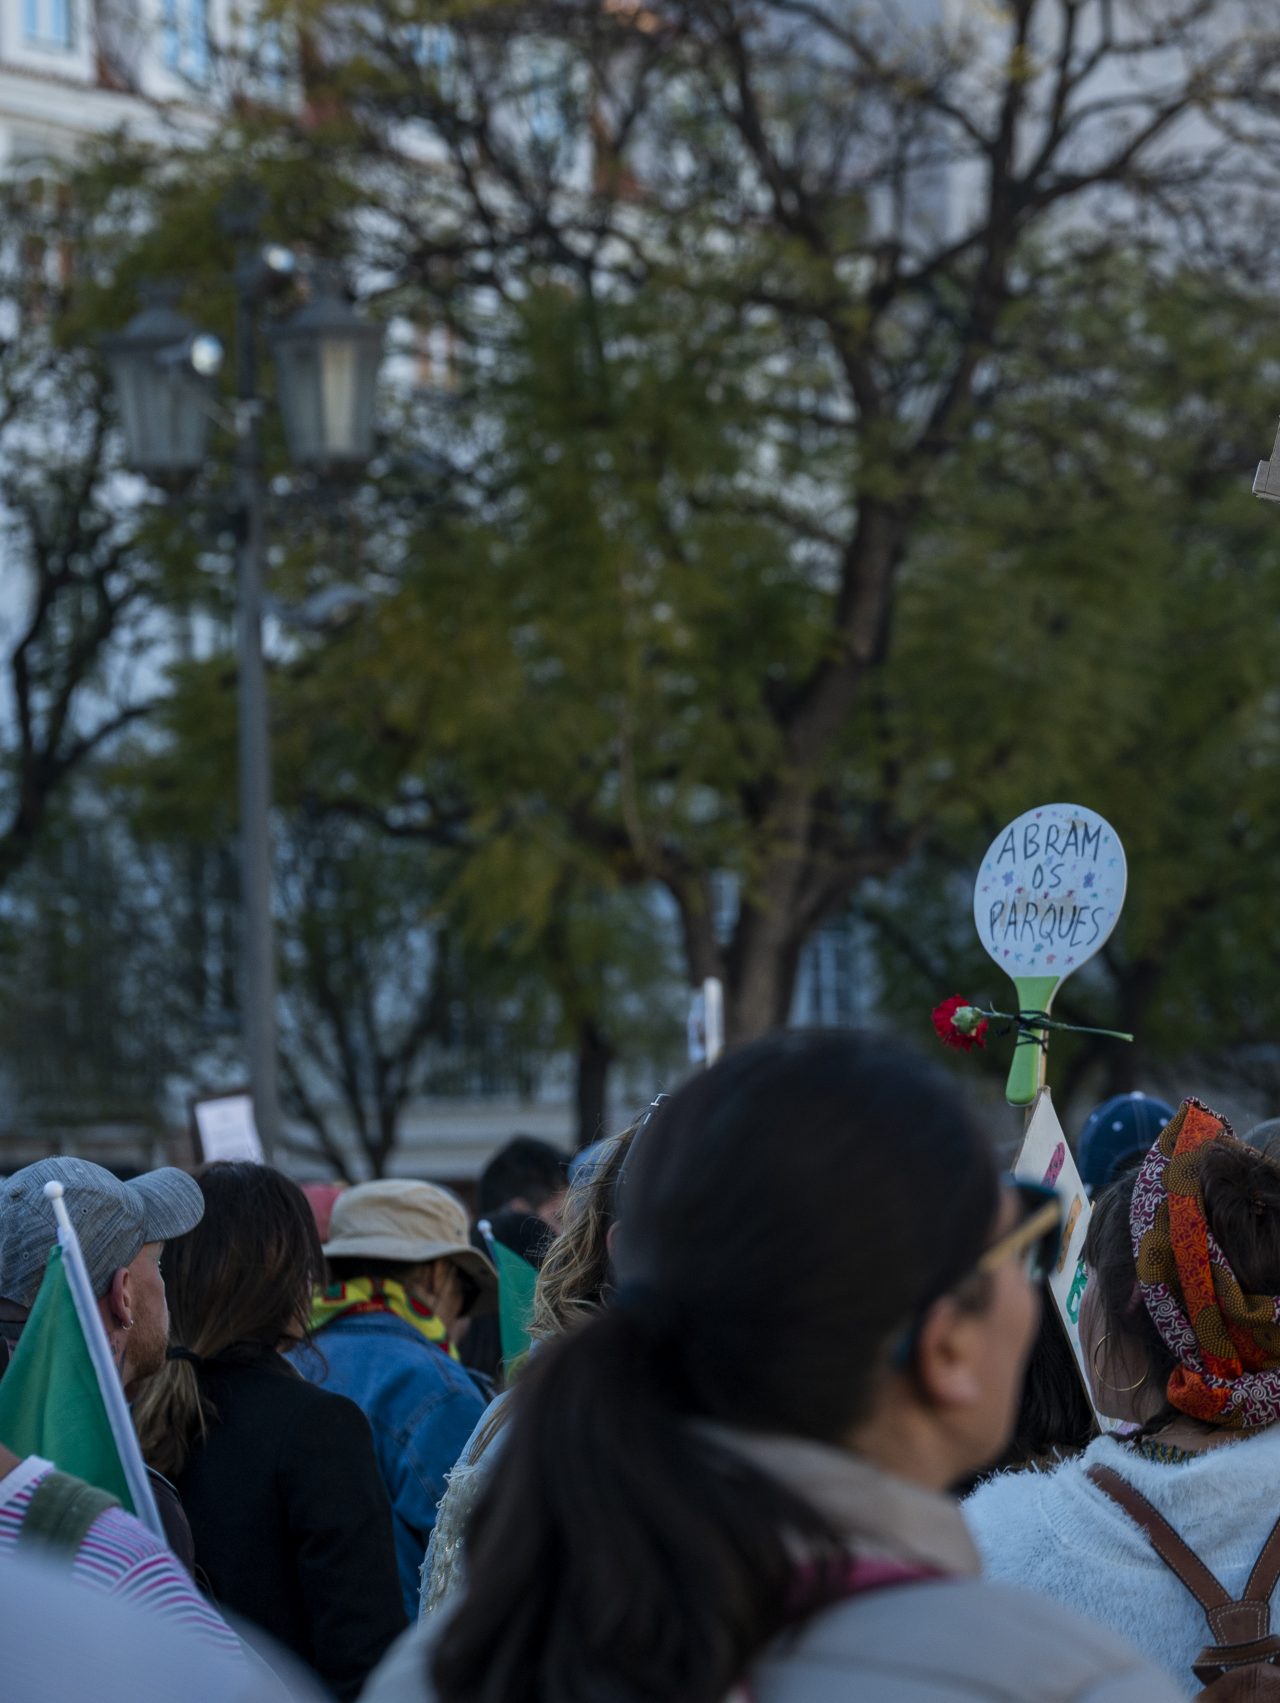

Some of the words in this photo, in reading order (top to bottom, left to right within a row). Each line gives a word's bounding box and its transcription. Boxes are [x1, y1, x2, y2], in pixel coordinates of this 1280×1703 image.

[997, 821, 1102, 864] ABRAM
[1032, 863, 1065, 889] OS
[989, 899, 1105, 947] PARQUES
